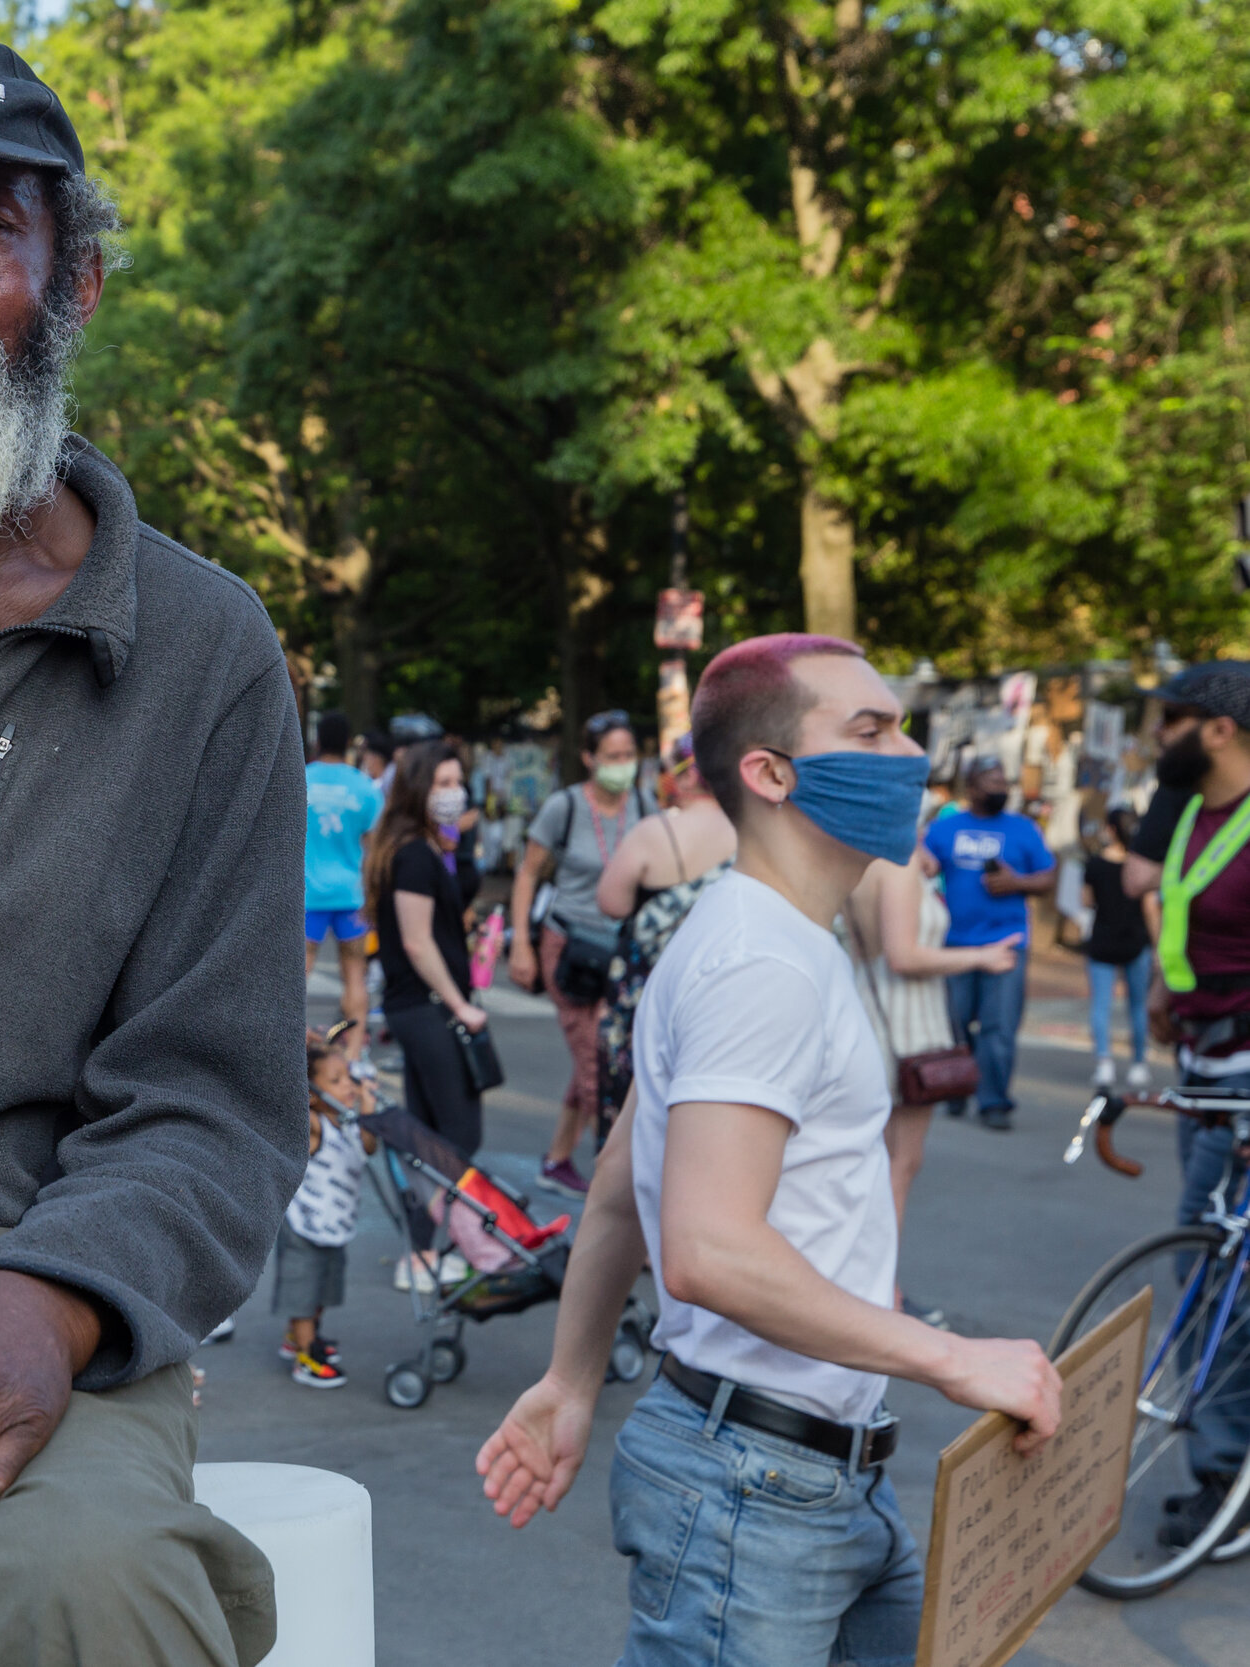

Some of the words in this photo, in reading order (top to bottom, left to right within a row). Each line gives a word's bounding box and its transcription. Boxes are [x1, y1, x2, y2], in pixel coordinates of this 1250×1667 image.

[956, 1495, 992, 1546] FROM
[1006, 1451, 1043, 1499] SLAVE
[959, 1441, 1010, 1508] POLICE
[948, 1554, 998, 1619] PROTECT
[1008, 1515, 1042, 1561] THEIR
[977, 1565, 1015, 1620] NEVER
